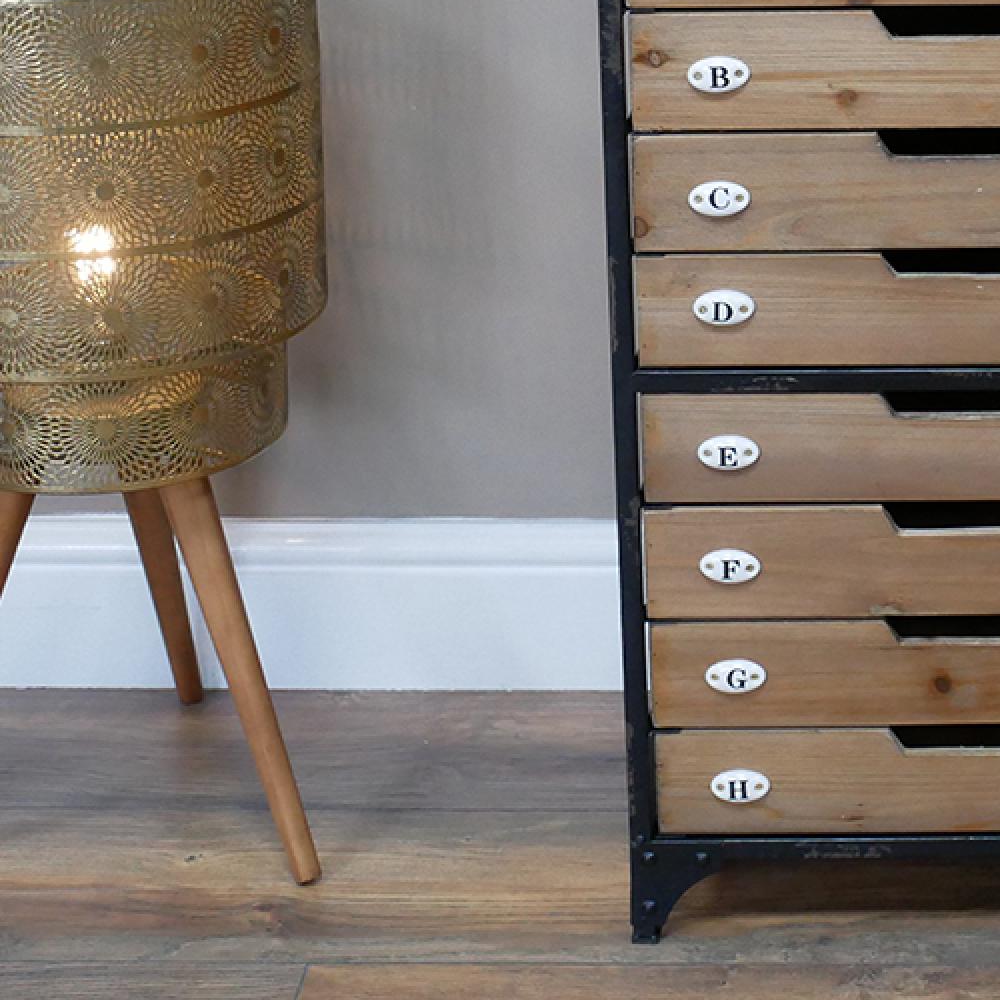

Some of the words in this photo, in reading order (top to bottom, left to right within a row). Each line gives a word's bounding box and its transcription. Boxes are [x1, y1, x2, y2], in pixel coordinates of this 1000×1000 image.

[710, 66, 731, 89] B
[709, 187, 731, 210] C
[712, 301, 734, 323] D
[718, 446, 739, 467] E
[722, 559, 741, 581] F
[726, 667, 747, 689] G
[728, 780, 749, 800] H
